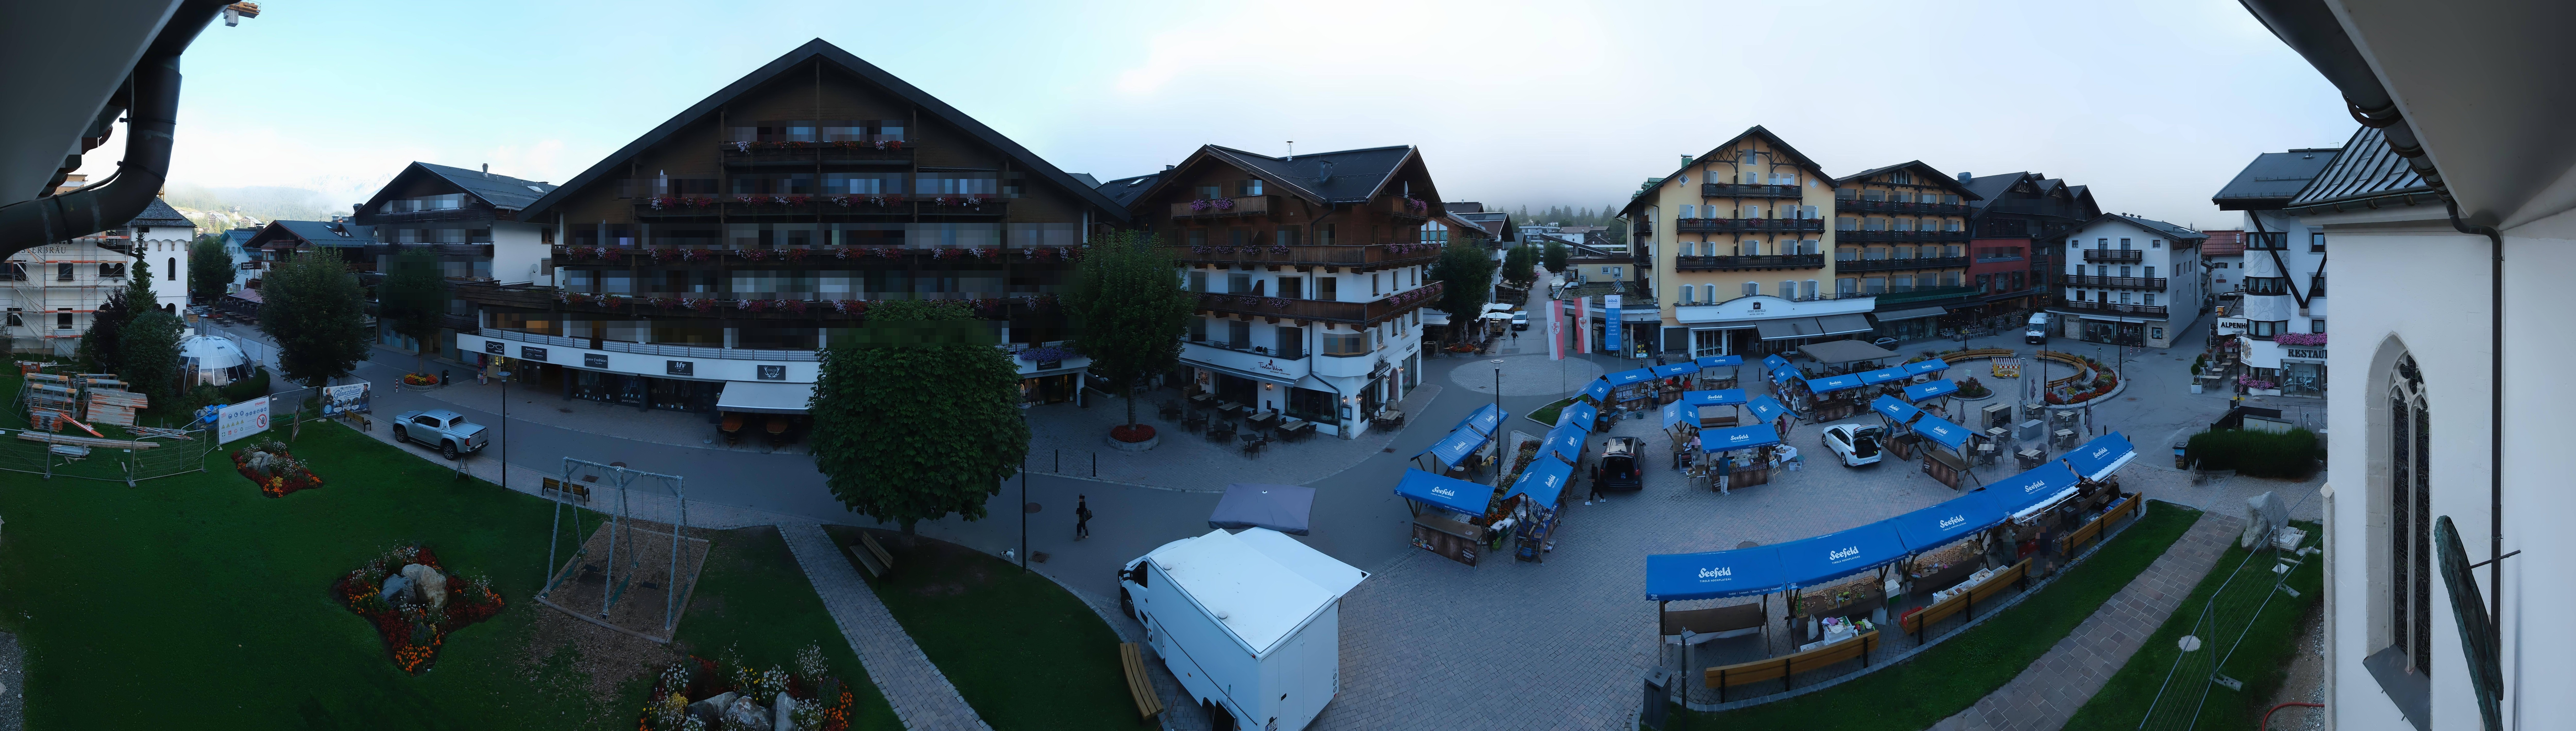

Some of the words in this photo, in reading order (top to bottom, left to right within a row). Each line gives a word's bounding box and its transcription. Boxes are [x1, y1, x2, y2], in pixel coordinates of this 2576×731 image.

[1406, 343, 1415, 352] SAILER
[1376, 364, 1390, 378] RESTAURANT
[334, 387, 361, 401] Glanzbuam
[1934, 426, 1948, 434] Seefeld
[1454, 441, 1466, 451] Seefeld
[2093, 447, 2108, 458] Seefeld
[1545, 474, 1556, 487] Seefeld
[2025, 480, 2045, 492] Seefeld
[1432, 486, 1455, 497] Seefeld
[1940, 514, 1964, 528] Seefeld
[1829, 545, 1859, 560] Seefeld
[1698, 566, 1732, 578] Seefeld
